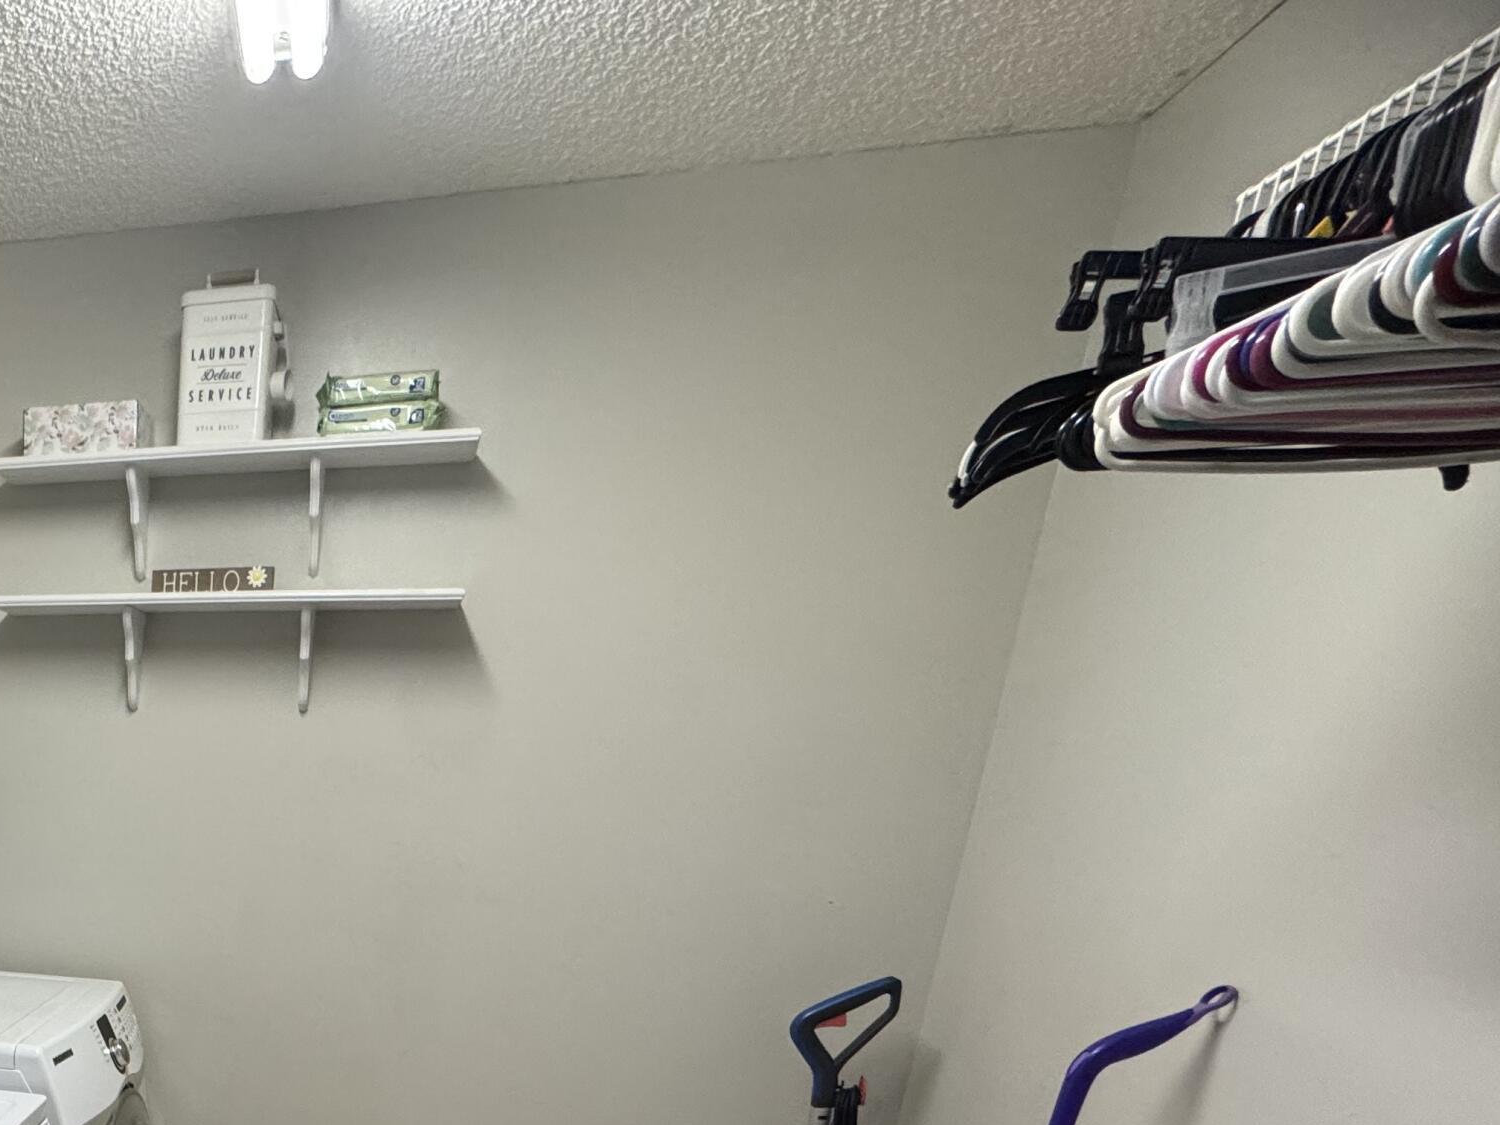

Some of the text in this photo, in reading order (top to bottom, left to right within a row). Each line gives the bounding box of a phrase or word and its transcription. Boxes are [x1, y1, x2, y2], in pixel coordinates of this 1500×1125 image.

[190, 345, 255, 361] LAUNDRY
[200, 368, 242, 381] Deluxe
[188, 387, 252, 402] SERVICE
[162, 570, 241, 592] HELLO
